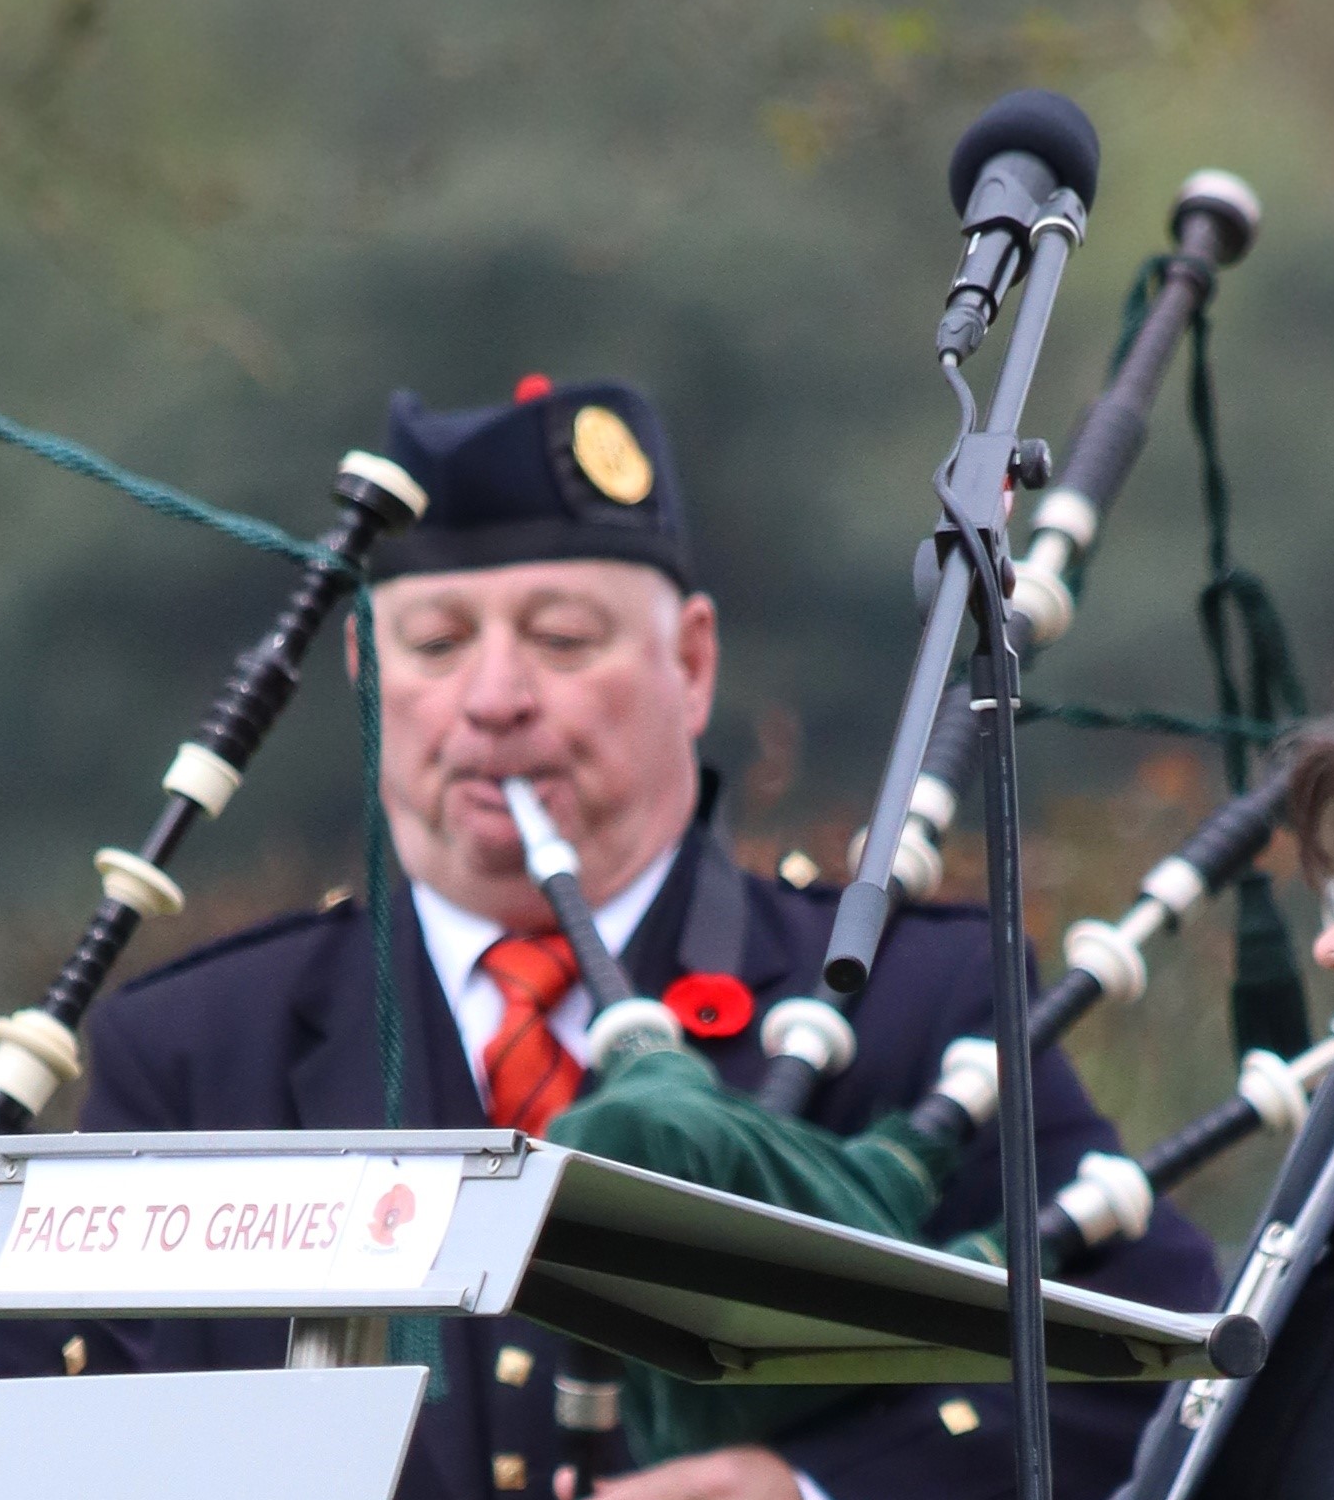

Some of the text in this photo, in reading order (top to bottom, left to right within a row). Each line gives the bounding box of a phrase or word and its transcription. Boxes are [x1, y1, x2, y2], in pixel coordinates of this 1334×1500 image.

[11, 1202, 346, 1252] FACES TO GRAVES
